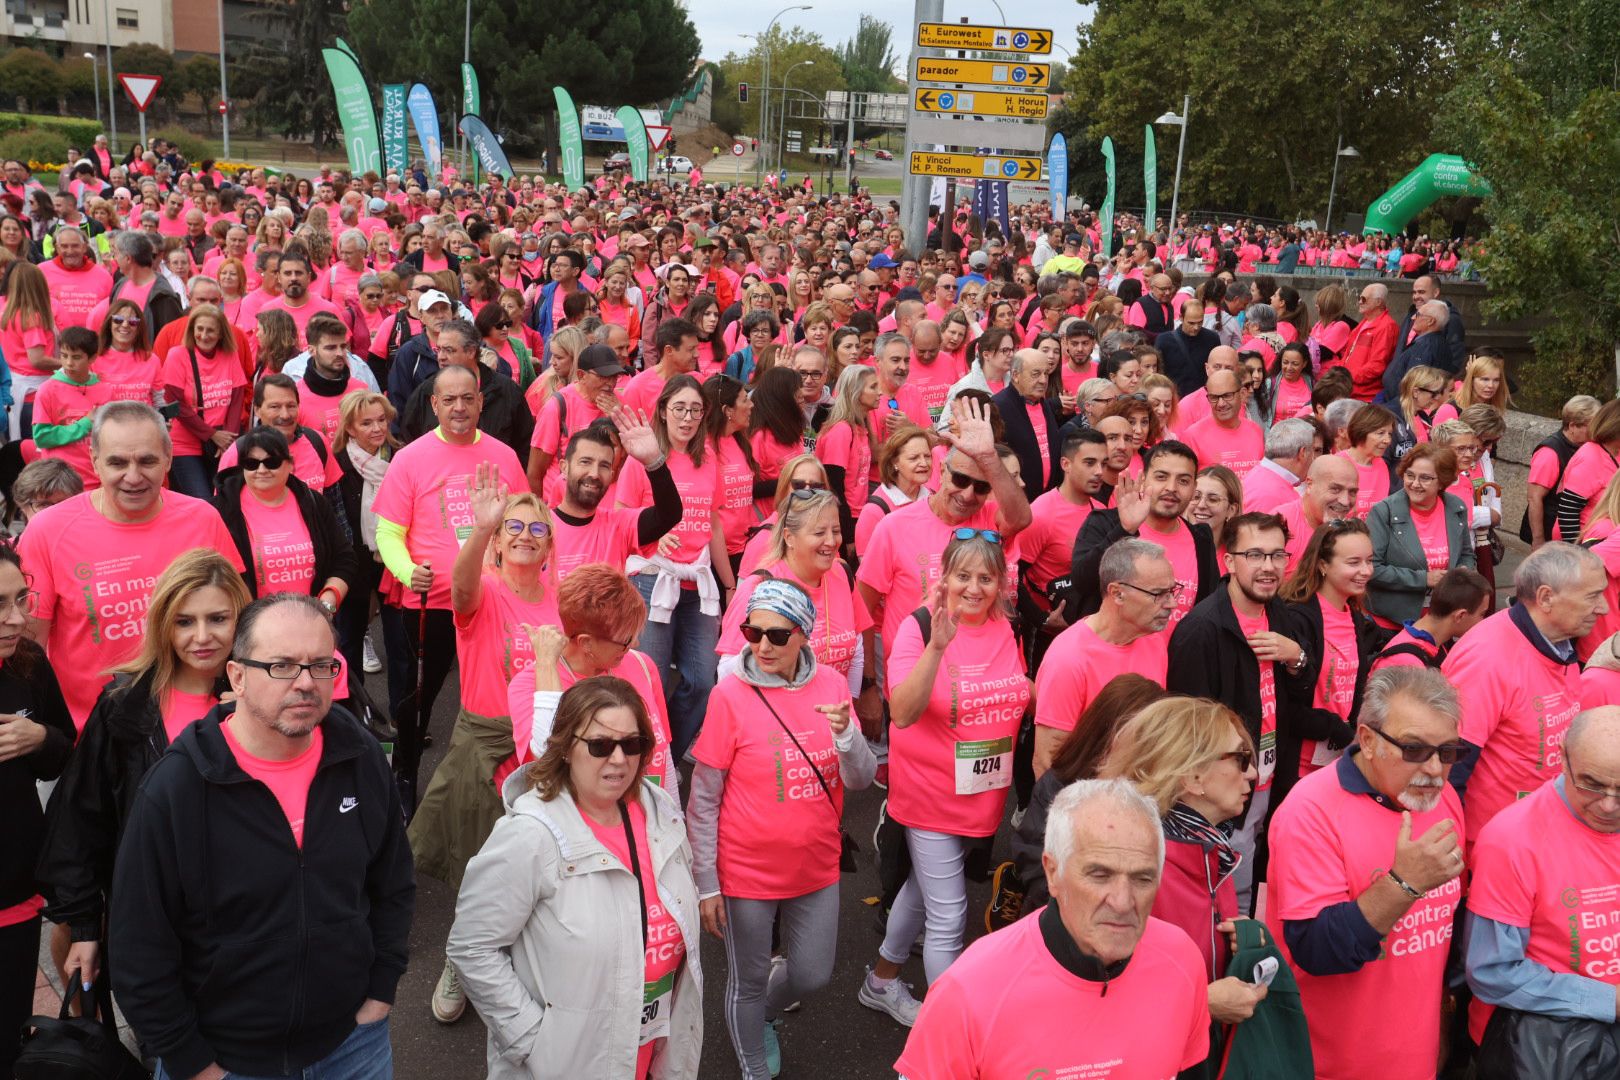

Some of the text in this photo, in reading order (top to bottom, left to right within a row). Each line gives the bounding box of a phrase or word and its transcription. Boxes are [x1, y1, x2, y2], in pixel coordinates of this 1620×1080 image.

[921, 26, 982, 38] H. Eurowest
[920, 66, 959, 75] parador
[1005, 96, 1044, 106] H. Horus
[1006, 105, 1044, 117] H. Regio
[913, 155, 951, 164] H. Vincci
[912, 164, 972, 174] H. P. Romano
[1434, 171, 1458, 180] contra
[922, 390, 944, 400] ontra
[724, 475, 736, 484] En
[446, 488, 461, 498] En
[264, 546, 282, 555] En
[268, 567, 316, 584] cánc
[96, 581, 122, 597] En
[100, 592, 152, 618] cont
[514, 638, 532, 652] En
[1337, 658, 1349, 670] En
[960, 673, 1026, 692] En marcha
[962, 690, 1018, 710] contra
[1334, 686, 1354, 703] cán
[784, 748, 804, 762] En
[973, 756, 1000, 775] 4274
[342, 797, 356, 806] NIKE
[1424, 876, 1461, 898] arch
[1392, 904, 1451, 932] contra
[1581, 912, 1607, 930] En
[647, 922, 681, 943] tra
[1056, 1058, 1123, 1075] asociación española
